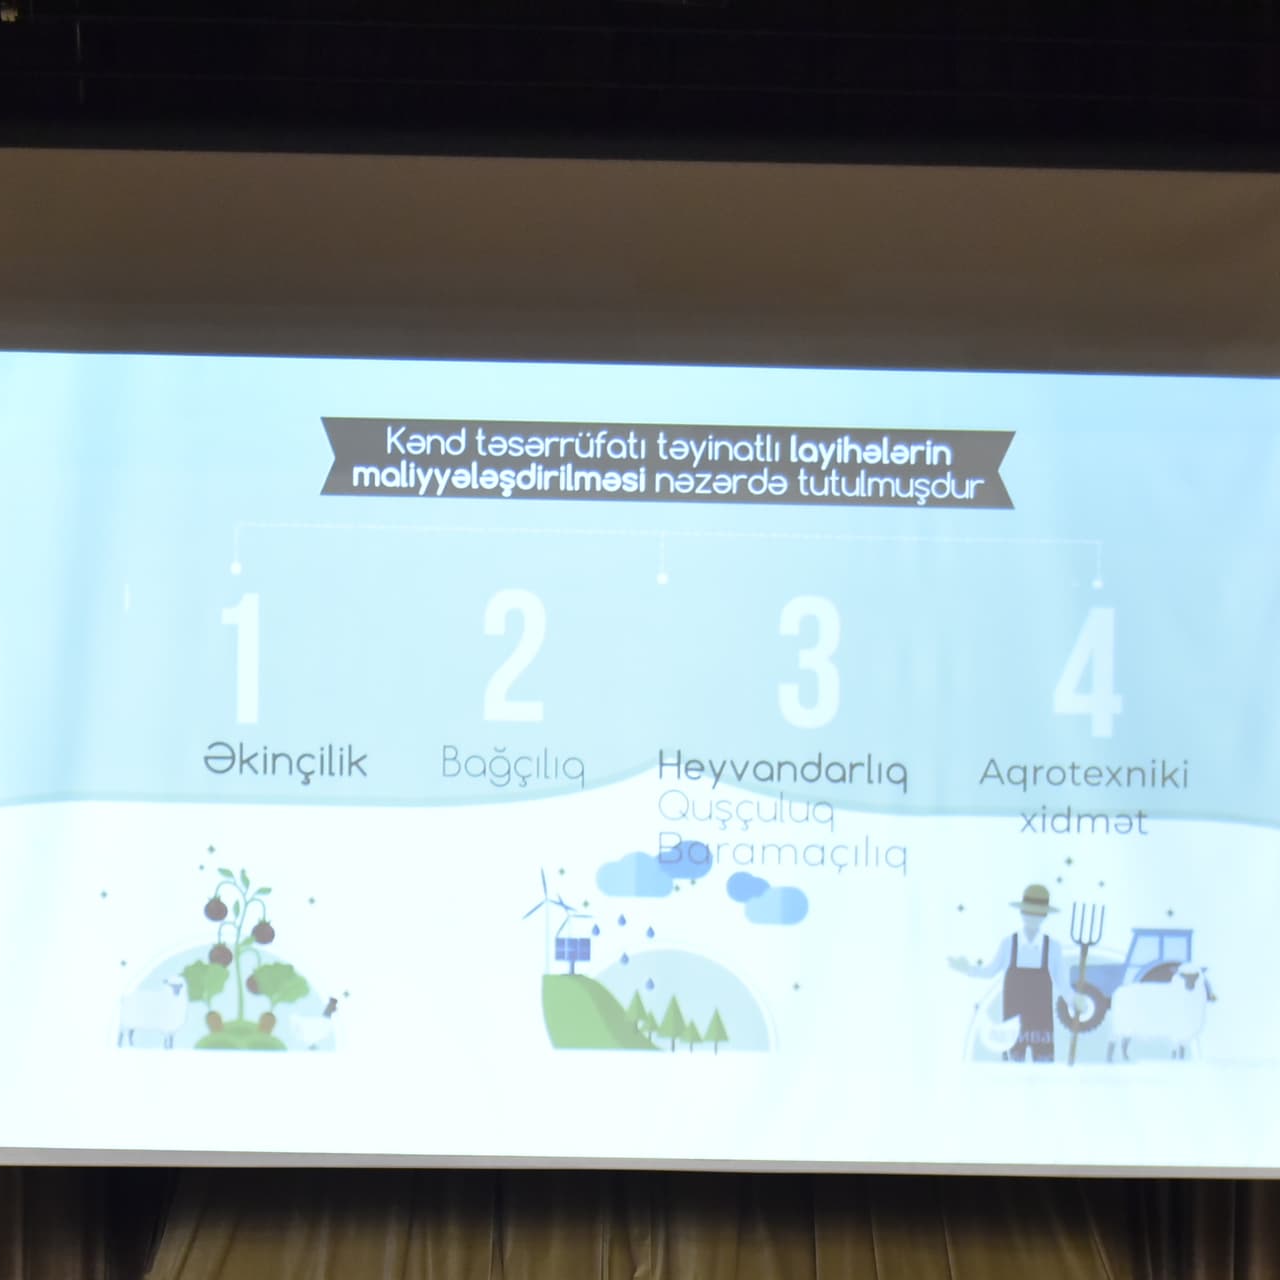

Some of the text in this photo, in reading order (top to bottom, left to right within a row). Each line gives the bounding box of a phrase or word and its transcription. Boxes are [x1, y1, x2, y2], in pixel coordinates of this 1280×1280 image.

[386, 426, 952, 471] Kənd təsərrüfatı təyinatlı layihələrin
[352, 459, 985, 506] maliyyələşdirilməsi nəzərdə tutulmuşdur
[221, 592, 260, 724] 1
[483, 588, 547, 722] 2
[777, 595, 841, 729] 3
[1052, 606, 1123, 738] 4
[203, 741, 368, 785] Əkinçilik
[442, 744, 585, 790] Bağçılıq
[658, 749, 909, 793] Heyvandarlıq
[979, 757, 1189, 793] Aqrotexniki
[658, 789, 835, 831] Quşçuluq
[1020, 806, 1149, 836] xidmət
[657, 831, 909, 876] Baramaçılıq
